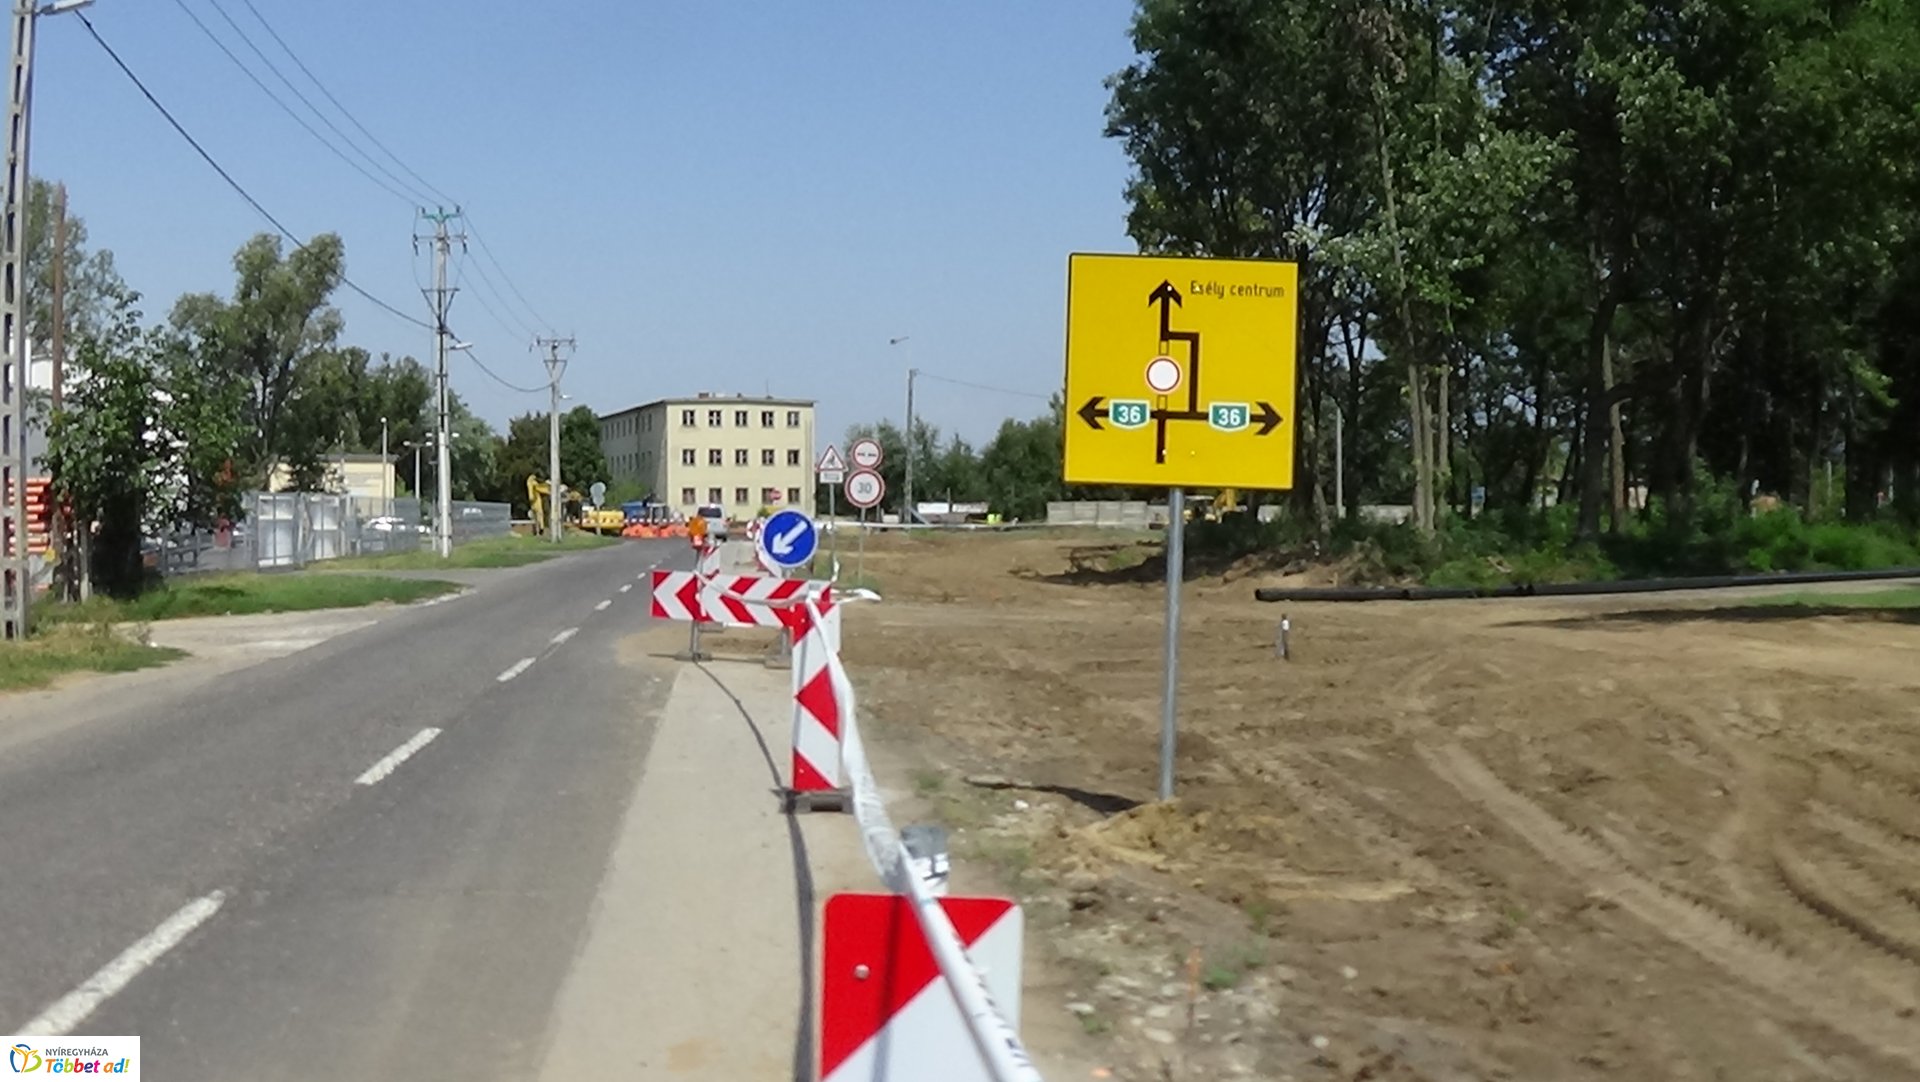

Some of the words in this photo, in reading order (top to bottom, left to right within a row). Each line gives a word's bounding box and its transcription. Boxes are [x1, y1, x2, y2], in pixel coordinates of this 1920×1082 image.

[1190, 280, 1225, 299] Esély
[1230, 283, 1285, 298] centrum
[1117, 405, 1141, 423] 36
[1218, 408, 1241, 426] 36
[857, 482, 873, 494] 30
